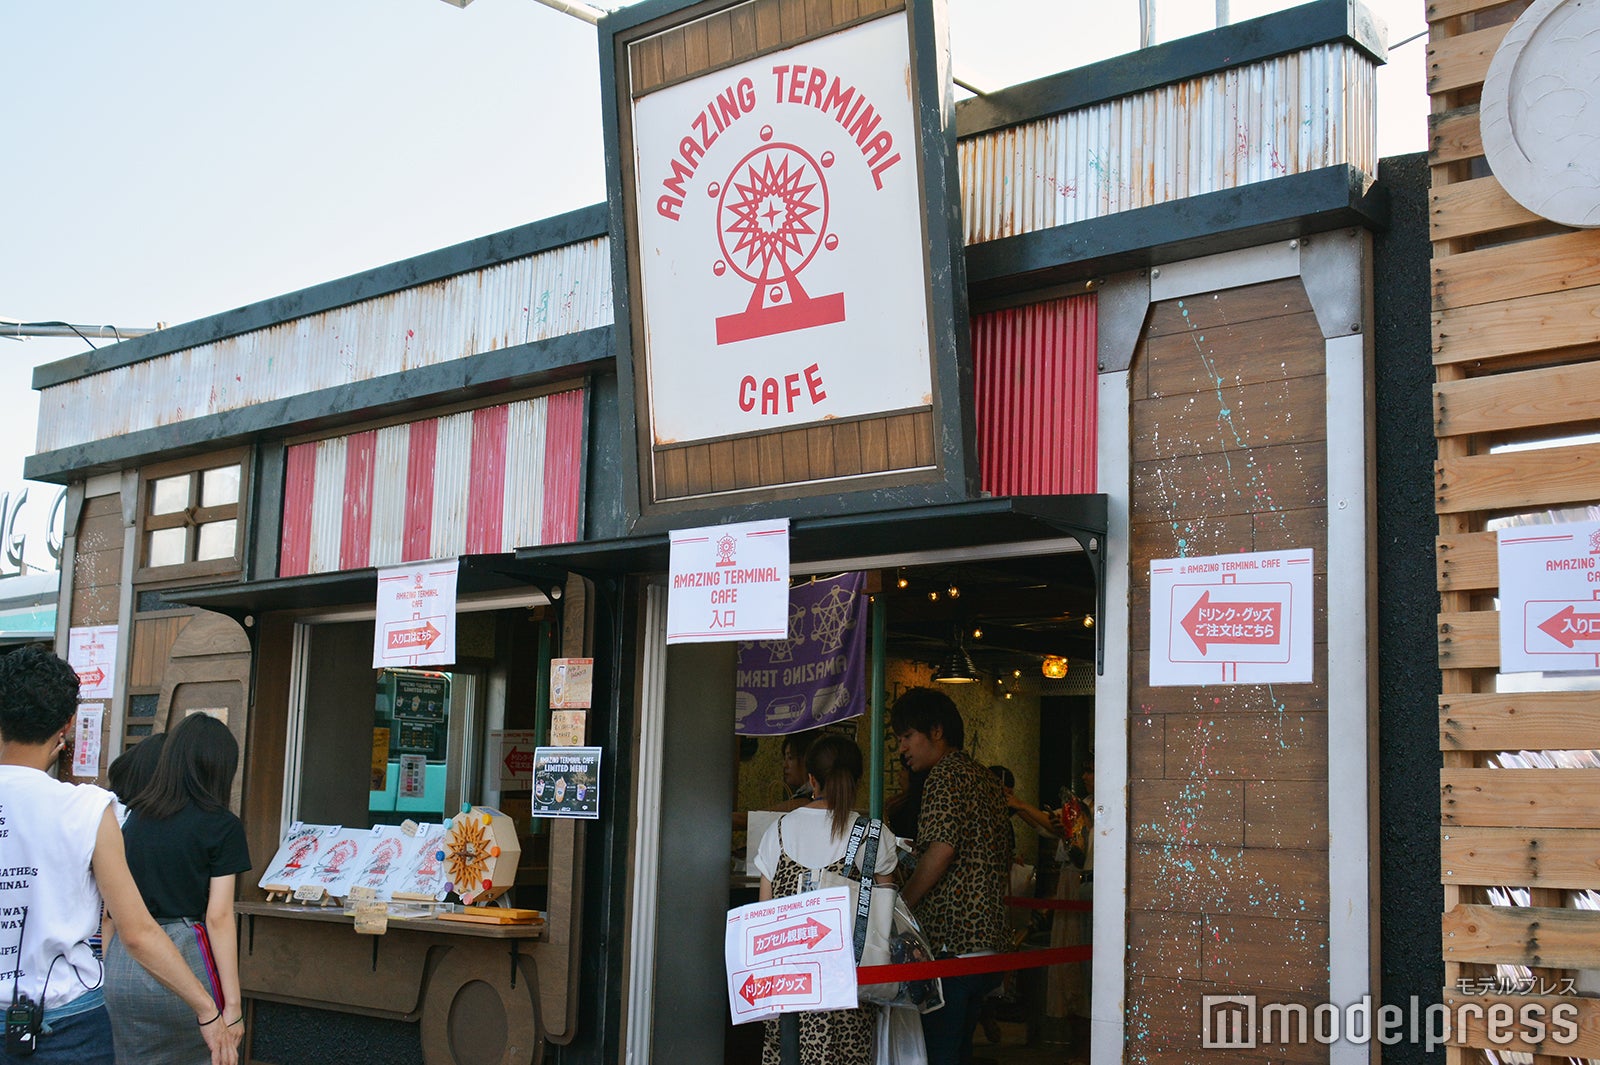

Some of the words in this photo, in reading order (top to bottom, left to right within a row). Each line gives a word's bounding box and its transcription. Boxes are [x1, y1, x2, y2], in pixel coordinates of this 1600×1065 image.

[656, 76, 756, 222] AMAZING
[772, 64, 902, 191] TERMINAL
[738, 362, 827, 416] CAFE
[1187, 561, 1219, 574] AMAZING
[1222, 560, 1259, 573] TERMINAL
[1261, 558, 1281, 569] CAFE
[1546, 557, 1595, 571] AMAZING
[673, 571, 720, 589] AMAZING
[724, 566, 781, 585] TERMINAL
[710, 588, 738, 605] CAFE
[709, 609, 736, 629] 入口
[1198, 607, 1275, 622] ドリンク・グッズ
[1194, 623, 1275, 638] ご注文はこちら
[0, 867, 39, 877] ATHES
[0, 906, 28, 916] WAY
[749, 907, 776, 919] AMAZING
[777, 900, 804, 913] TERMINAL
[805, 897, 821, 908] CAFE
[0, 945, 18, 956] IFE
[745, 976, 807, 998] ドリンク・グッズ
